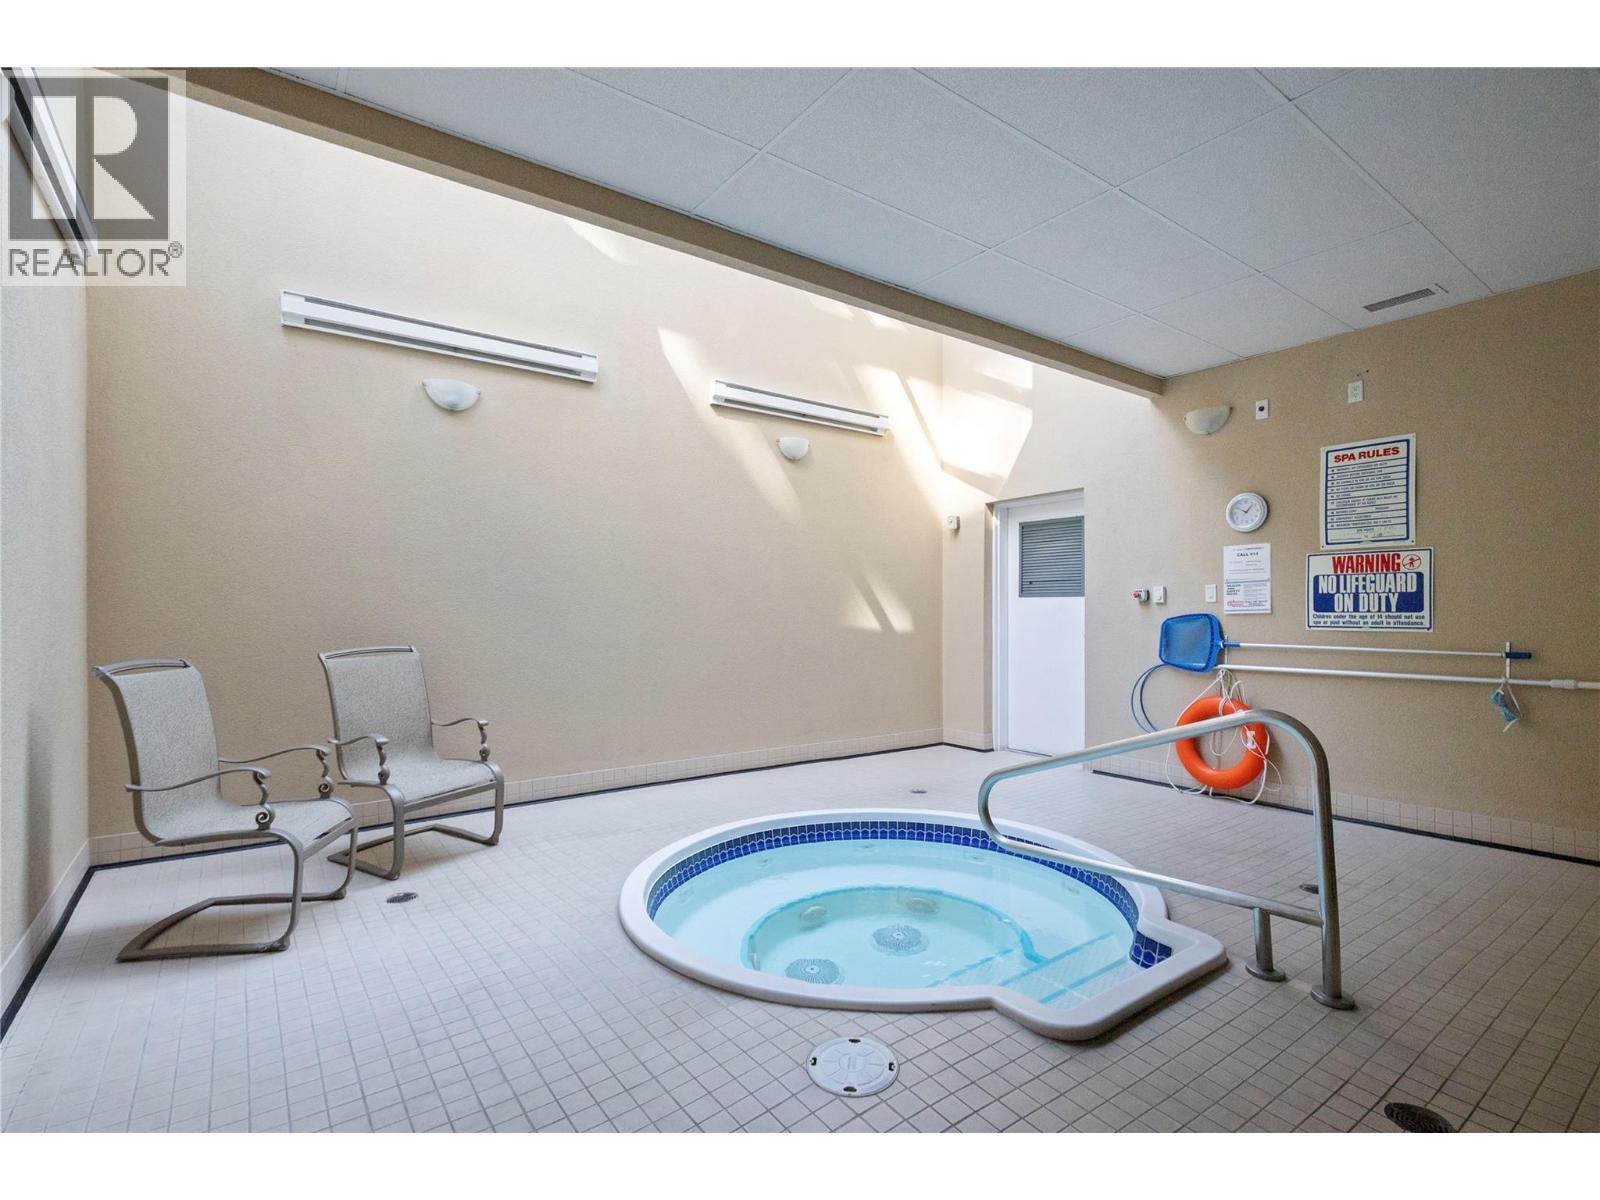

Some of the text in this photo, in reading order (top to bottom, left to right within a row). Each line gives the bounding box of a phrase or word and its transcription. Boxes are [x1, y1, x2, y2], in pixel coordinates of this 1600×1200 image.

[1334, 446, 1400, 463] SPA RULES
[1331, 552, 1401, 574] WARNING
[1318, 572, 1418, 594] NO LIFEGUARD
[1334, 592, 1399, 613] ON DUTY
